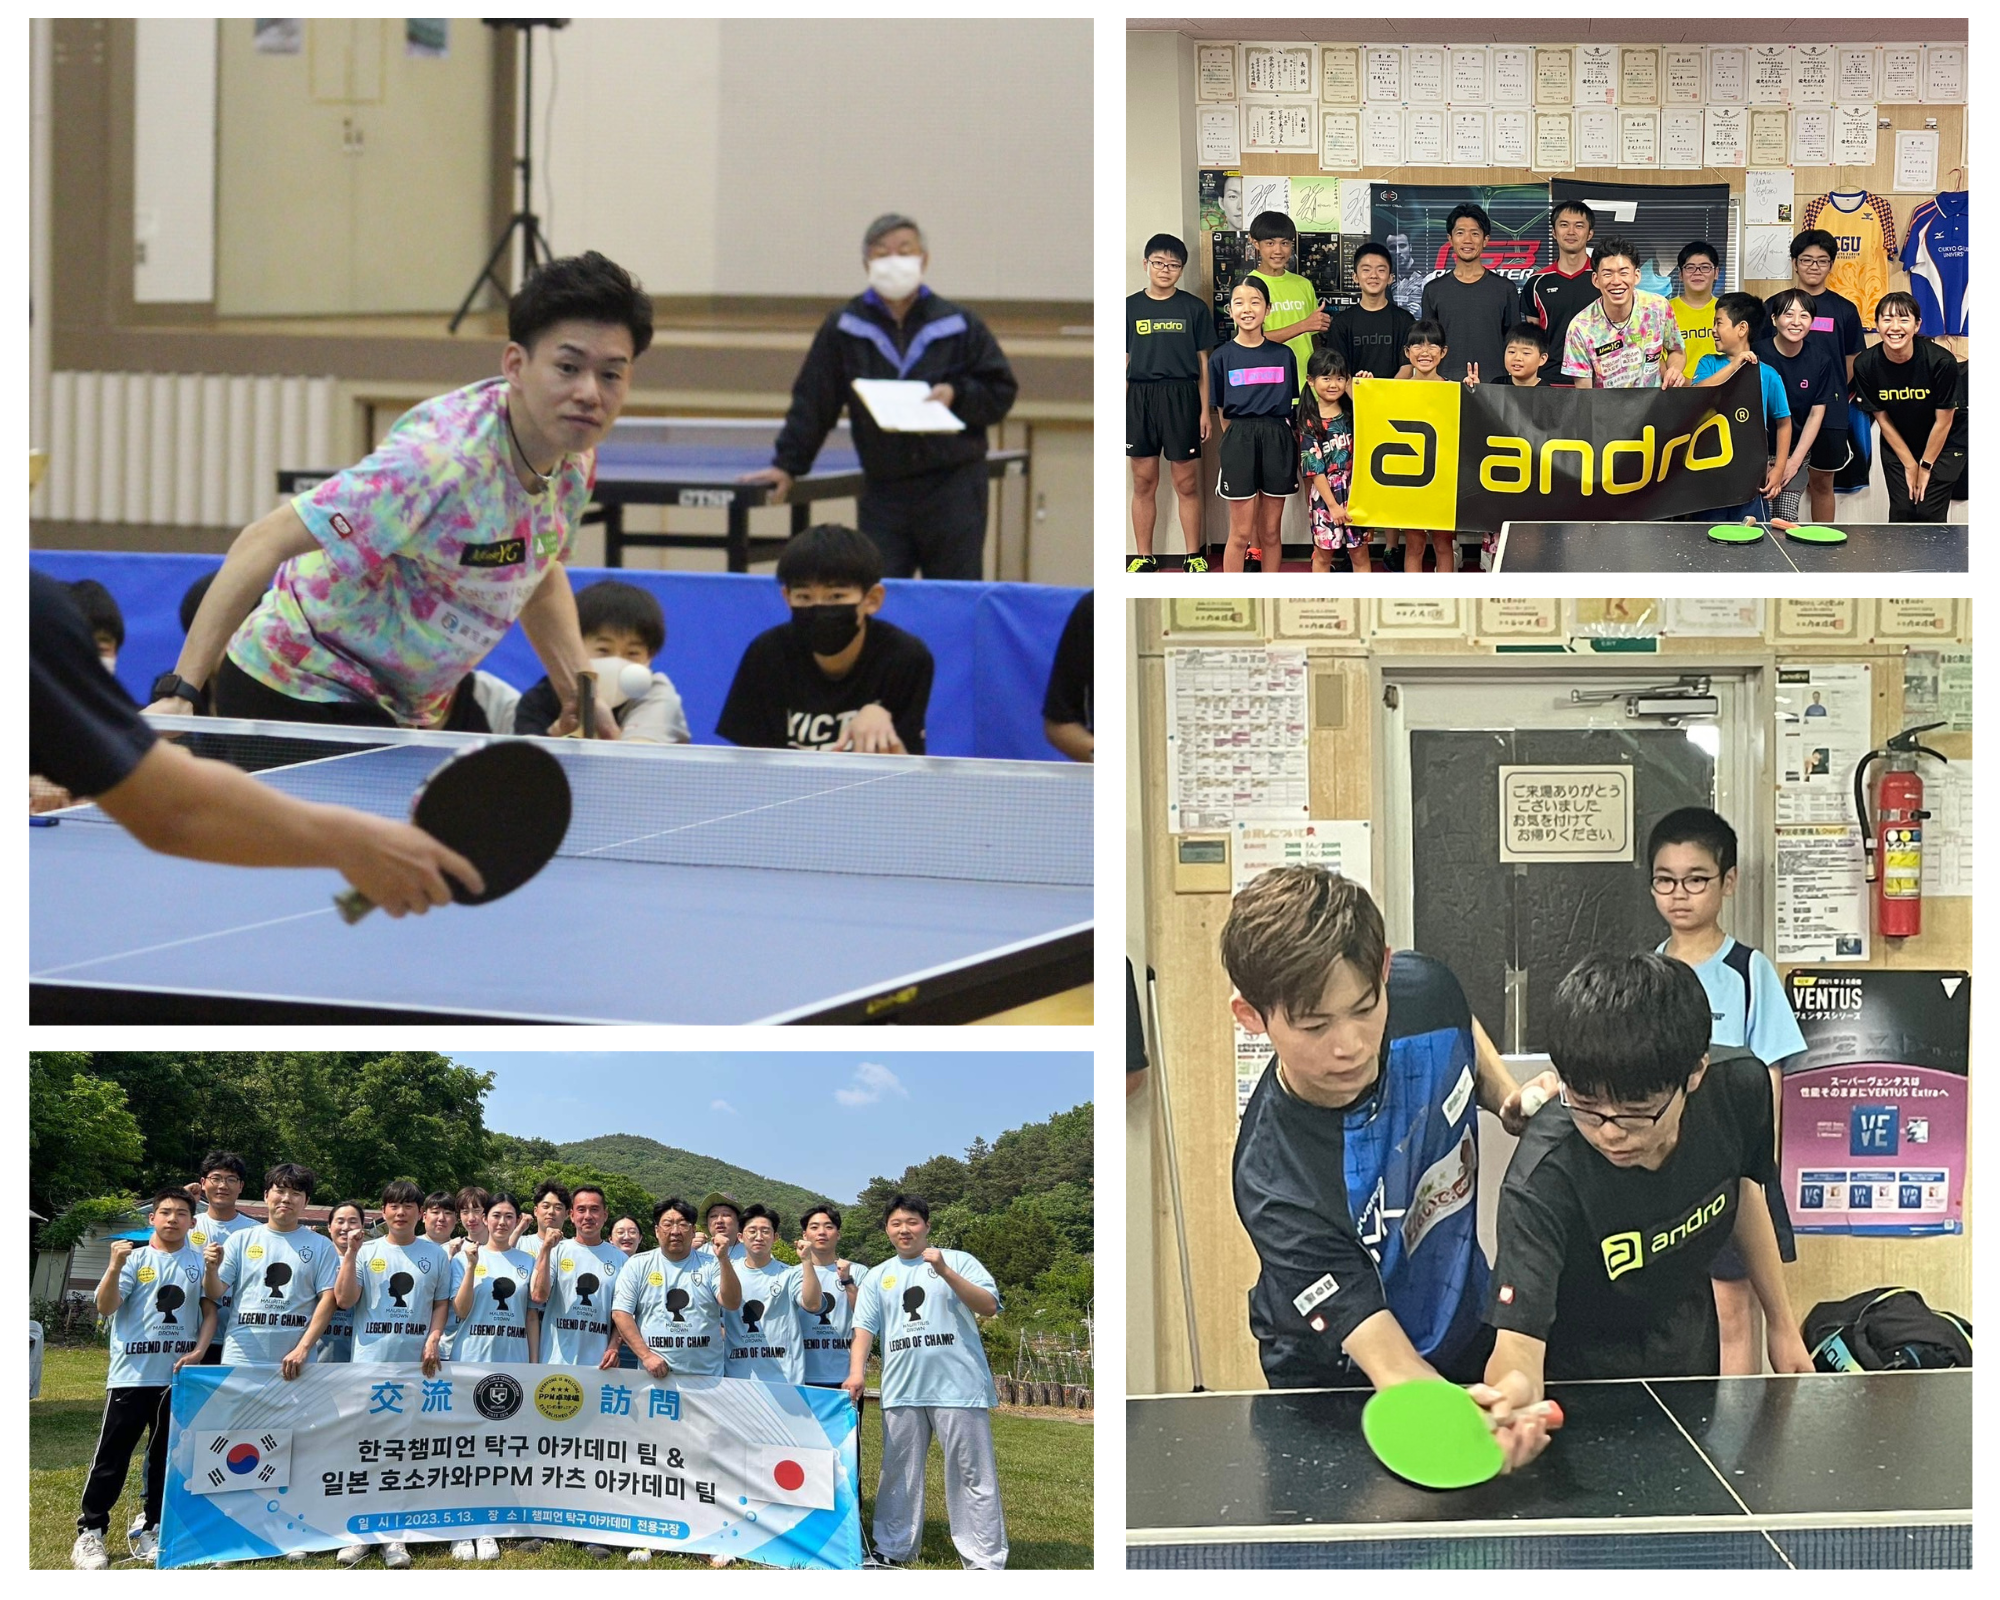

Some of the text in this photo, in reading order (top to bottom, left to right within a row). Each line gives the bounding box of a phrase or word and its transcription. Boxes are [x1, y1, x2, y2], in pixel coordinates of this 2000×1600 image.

[1153, 321, 1183, 330] andro
[1353, 333, 1392, 346] andro
[1681, 327, 1713, 340] andr
[1879, 387, 1927, 400] andro
[1322, 432, 1352, 454] andr
[1479, 413, 1734, 497] andro
[1513, 784, 1621, 798] ご来場ありがとう
[1517, 800, 1602, 813] ございました
[1513, 814, 1594, 828] お気を付けて
[1793, 987, 1863, 1010] VENTUS
[1650, 1193, 1726, 1253] andro
[238, 1313, 307, 1326] LEGEND OF CHAMP
[557, 1318, 608, 1335] LEGEND OF CHAM
[366, 1322, 392, 1334] LEGEND
[394, 1322, 403, 1334] OF
[470, 1325, 527, 1338] LEGEND OF CHAM
[126, 1341, 160, 1355] LEGEND
[163, 1341, 174, 1353] OF
[648, 1336, 711, 1348] LEGEND OF CHAMP
[821, 1339, 830, 1349] OF
[889, 1333, 955, 1352] LEGEND OF CHAMP
[750, 1348, 758, 1358] OF
[762, 1347, 786, 1359] CHAMP
[358, 1434, 685, 1469] 한국챔피언 탁구 아카데미 팀 &
[322, 1465, 716, 1504] 일본 호소카와PPM 카츠 아카데미 팀
[405, 1514, 441, 1526] 2023.
[443, 1513, 454, 1523] 5.
[457, 1512, 474, 1522] 13.
[531, 1510, 563, 1522] 챔피언
[566, 1512, 587, 1526] 탁구
[589, 1514, 631, 1531] 아카데미
[637, 1520, 680, 1536] 전용구장
